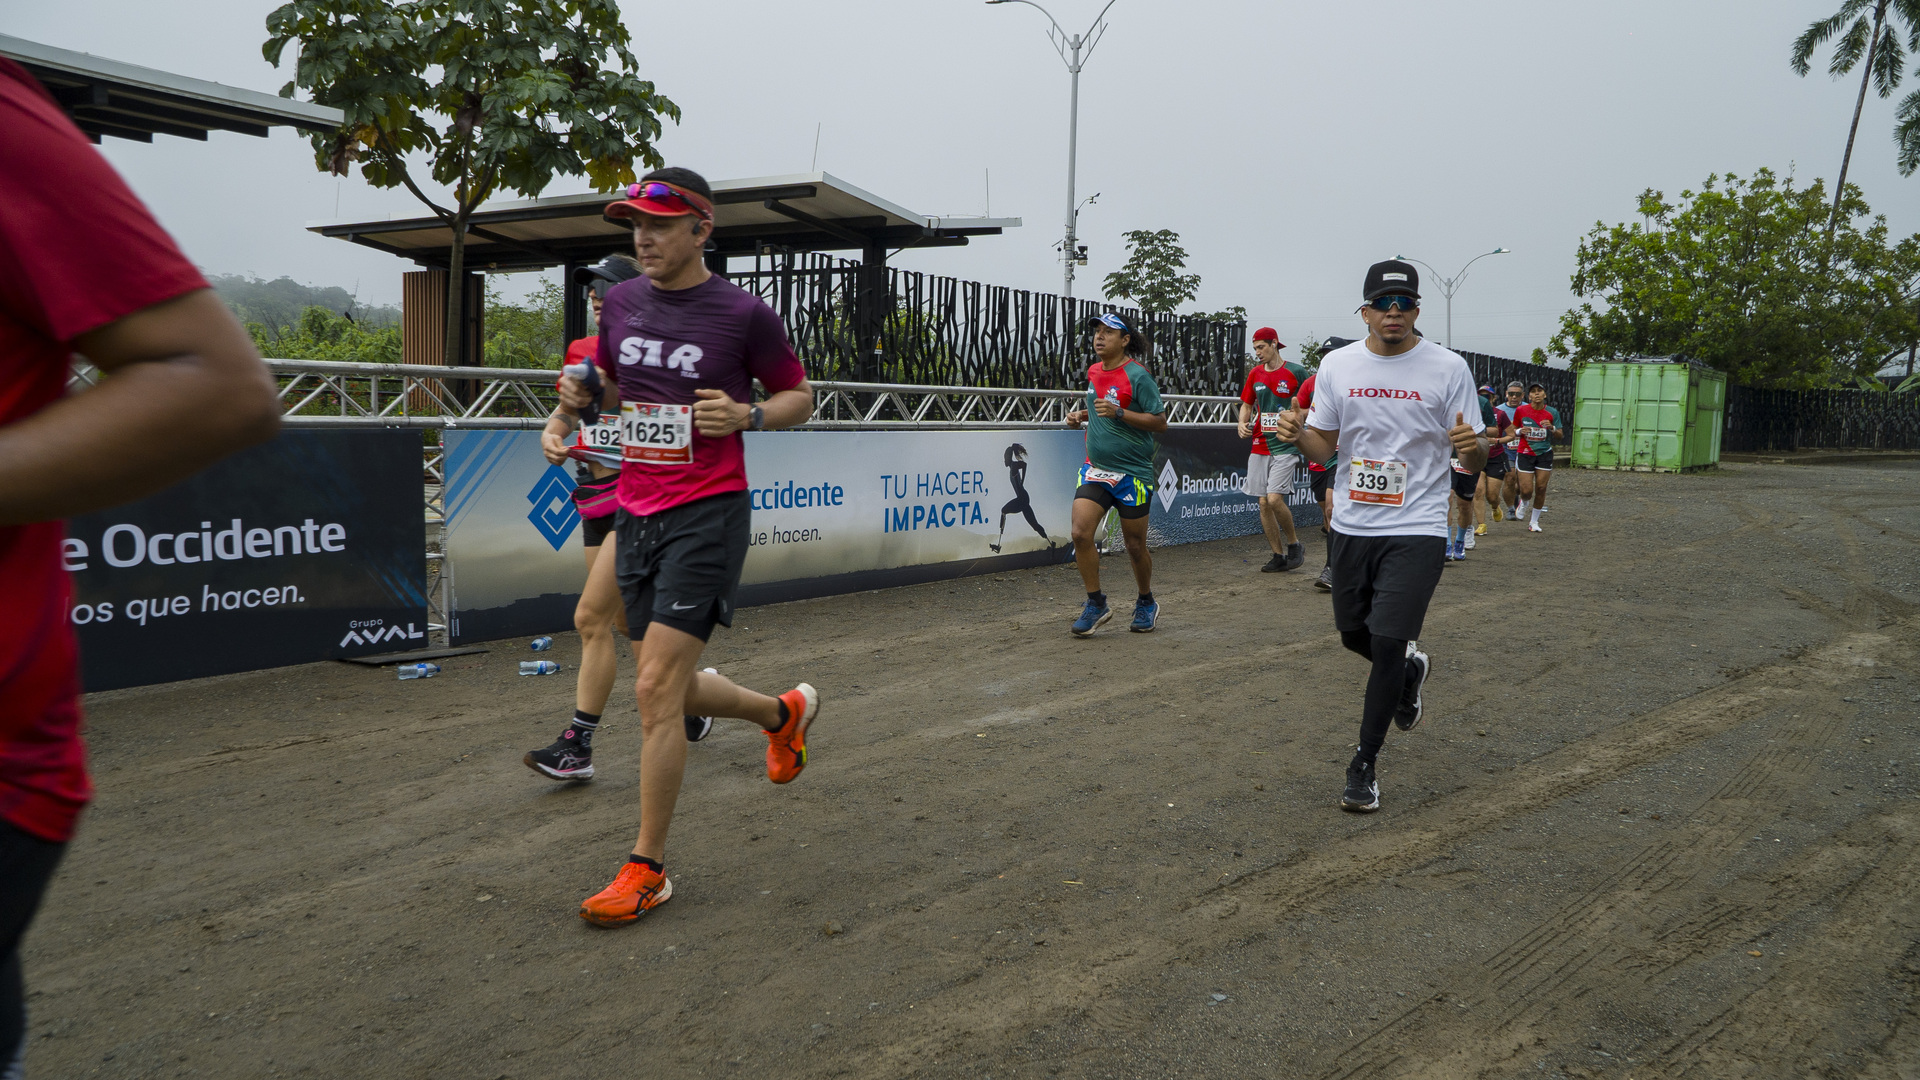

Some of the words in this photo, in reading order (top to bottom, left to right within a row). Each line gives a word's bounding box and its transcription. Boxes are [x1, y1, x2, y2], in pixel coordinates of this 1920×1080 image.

[1348, 388, 1423, 401] HONDA
[625, 421, 675, 444] 1625
[1263, 418, 1277, 426] 212
[590, 428, 621, 446] 192
[881, 474, 908, 500] TU
[916, 470, 989, 497] HACER,
[1182, 474, 1214, 494] Banco
[1216, 473, 1228, 491] de
[1356, 472, 1388, 491] 339
[750, 480, 844, 511] ccidente
[884, 501, 989, 533] IMPACTA.
[1181, 503, 1194, 519] Del
[1194, 503, 1211, 517] lado
[1211, 501, 1221, 515] de
[1221, 501, 1232, 514] los
[1232, 503, 1246, 516] que
[60, 537, 89, 572] e
[101, 517, 347, 568] Occidente
[749, 532, 768, 546] ue
[772, 524, 822, 545] hacen.
[70, 601, 115, 626] os
[125, 595, 191, 627] que
[201, 584, 306, 613] hacen.
[349, 618, 384, 629] Grupo
[339, 622, 424, 649] AVAL
